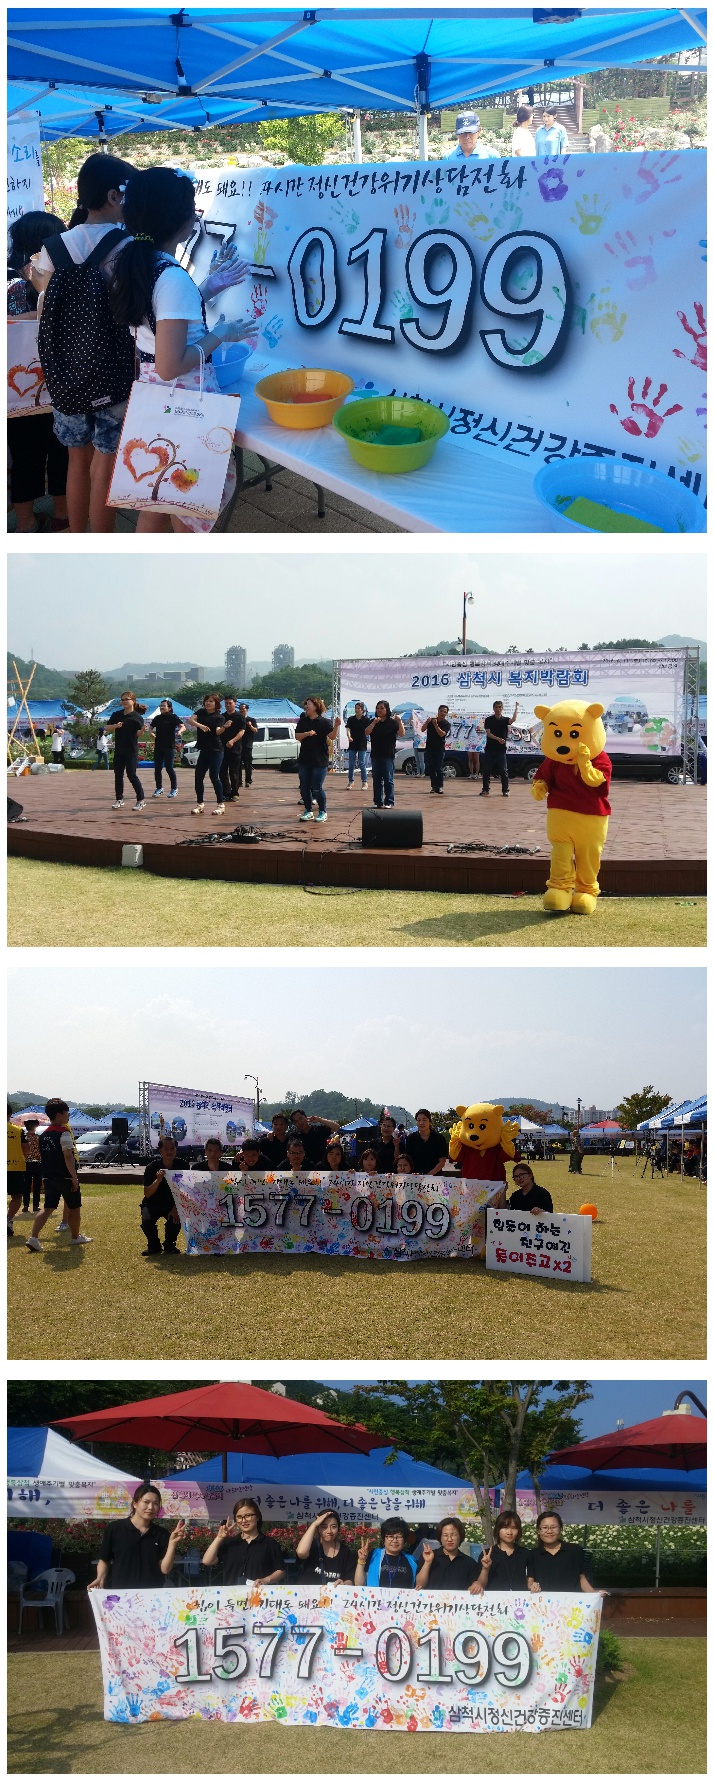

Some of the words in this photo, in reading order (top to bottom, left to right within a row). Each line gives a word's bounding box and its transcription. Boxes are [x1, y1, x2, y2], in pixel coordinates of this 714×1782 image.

[411, 674, 450, 688] 2016
[457, 671, 502, 689] 삼척시
[508, 669, 589, 688] 복지박람회
[219, 1192, 451, 1240] 1577-0199
[535, 1222, 560, 1236] 하는
[264, 1494, 288, 1509] 좋은
[289, 1496, 313, 1510] 나를
[343, 1499, 355, 1508] 더
[357, 1497, 379, 1511] 좋은
[380, 1497, 403, 1512] 날을
[404, 1499, 426, 1511] 위해
[587, 1501, 604, 1512] 더
[615, 1499, 651, 1515] 좋은
[661, 1500, 697, 1516] 나를
[342, 1599, 382, 1611] 24시간
[174, 1625, 532, 1688] 1577-0199
[448, 1705, 583, 1727] 삼척시정신건강증진센터
